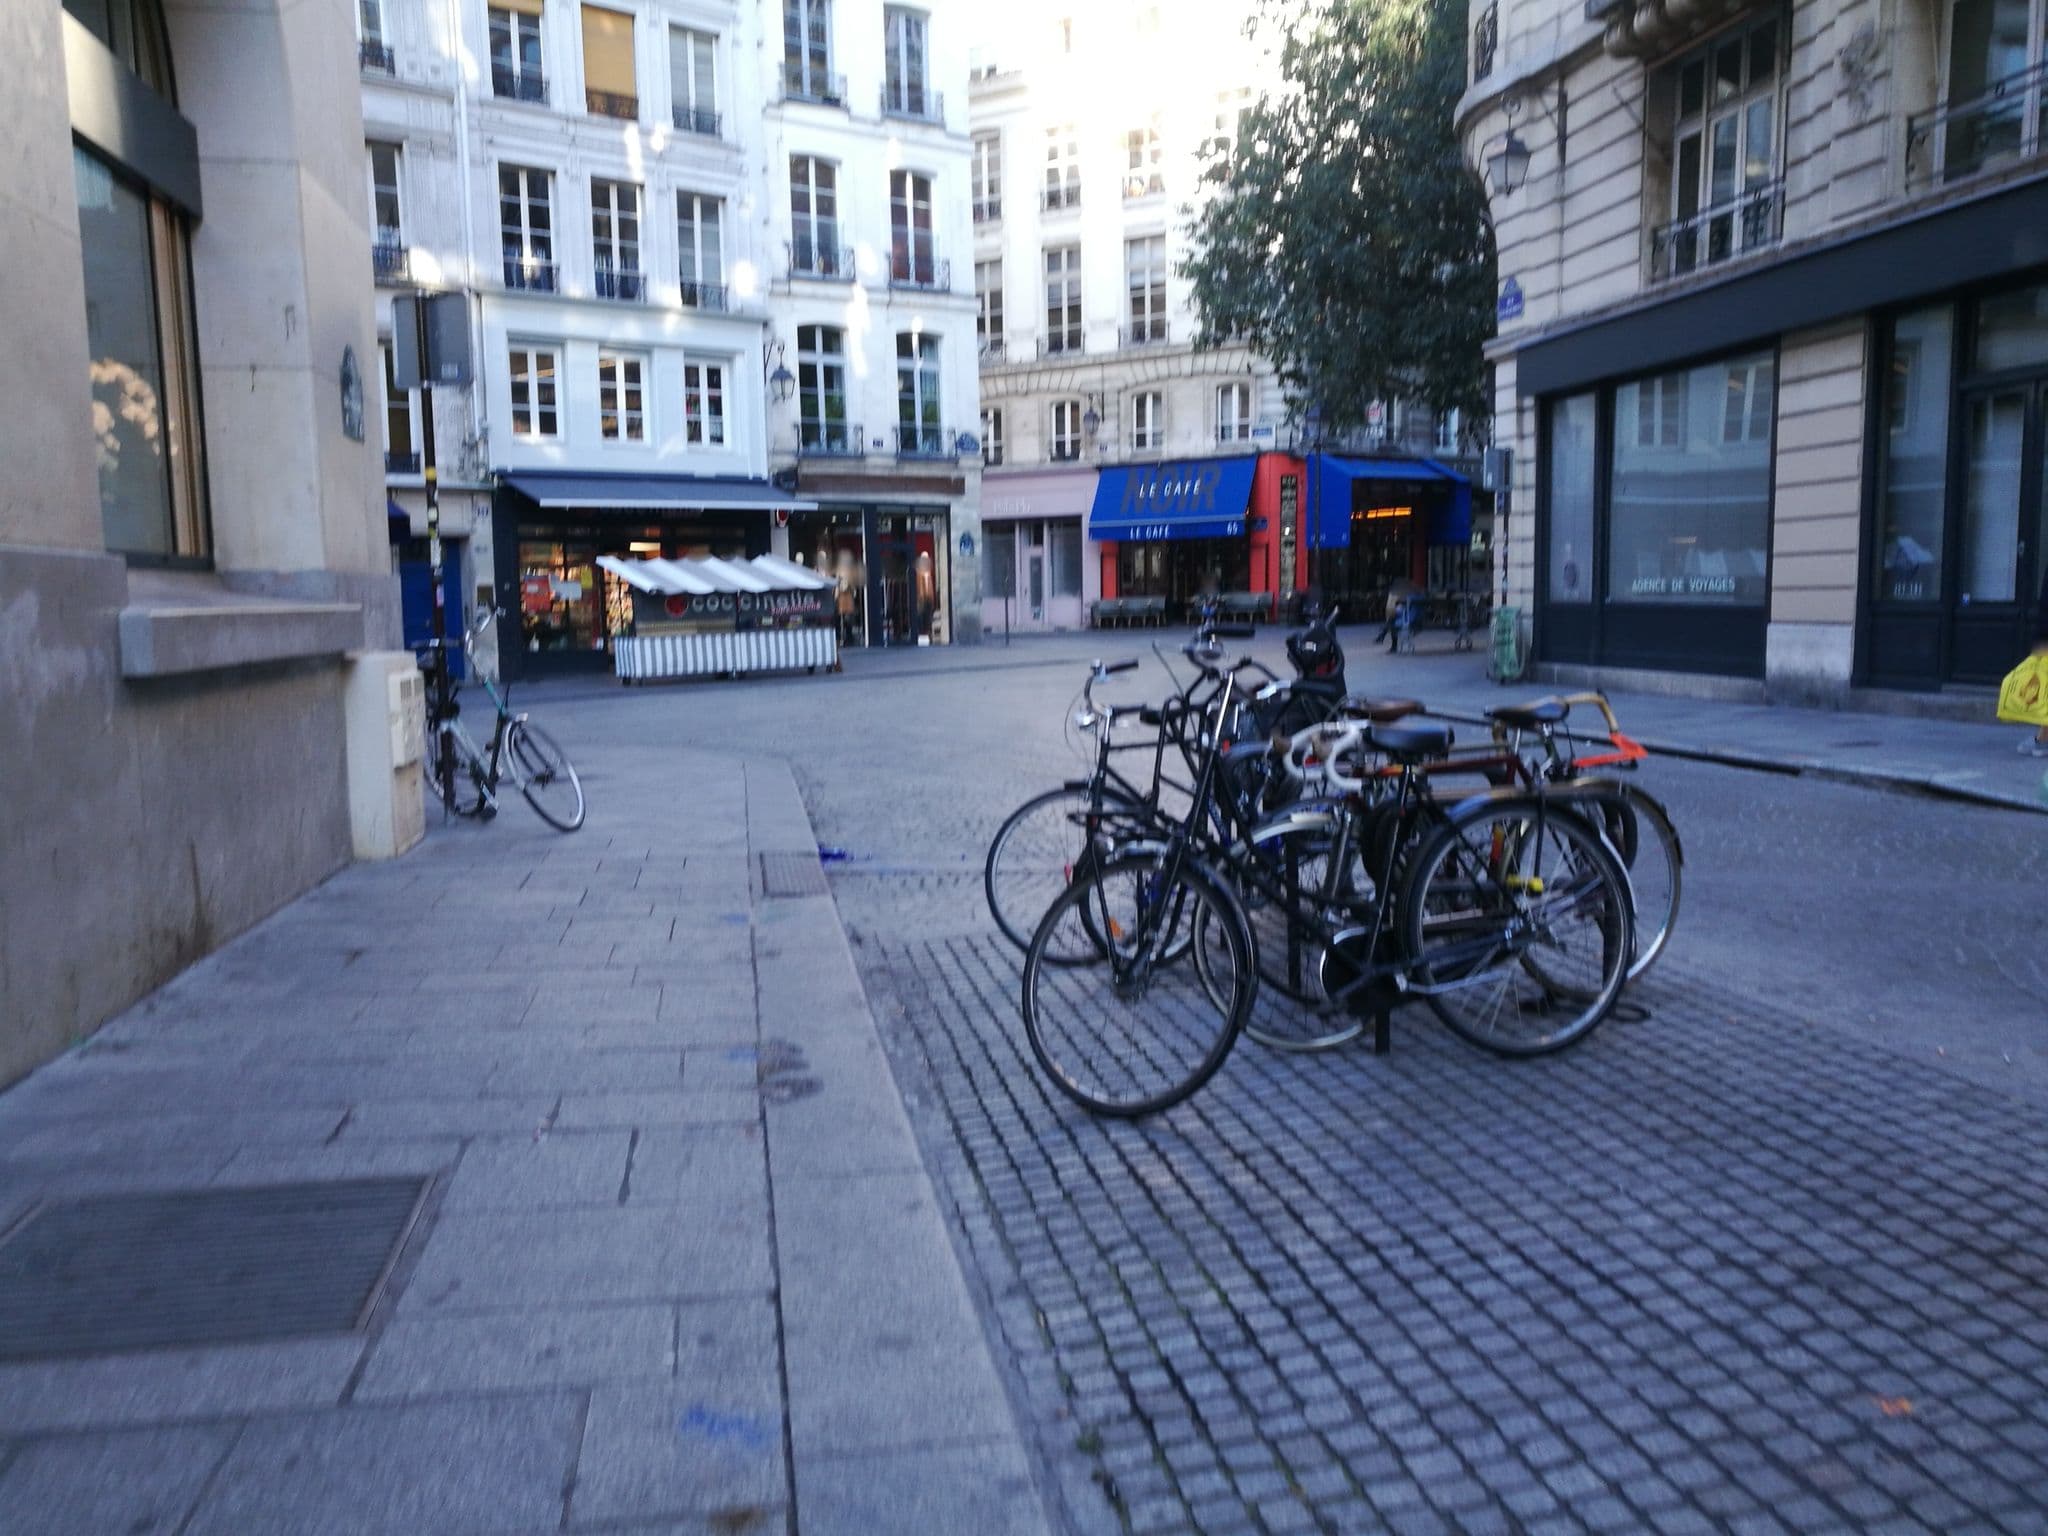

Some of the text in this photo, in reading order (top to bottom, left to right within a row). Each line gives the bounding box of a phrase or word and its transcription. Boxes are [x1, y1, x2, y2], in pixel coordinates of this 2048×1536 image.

[1119, 464, 1221, 514] NOIR
[1139, 482, 1156, 499] LE
[1129, 526, 1141, 540] LE
[1631, 575, 1735, 593] AGENCE DE VOYAGES
